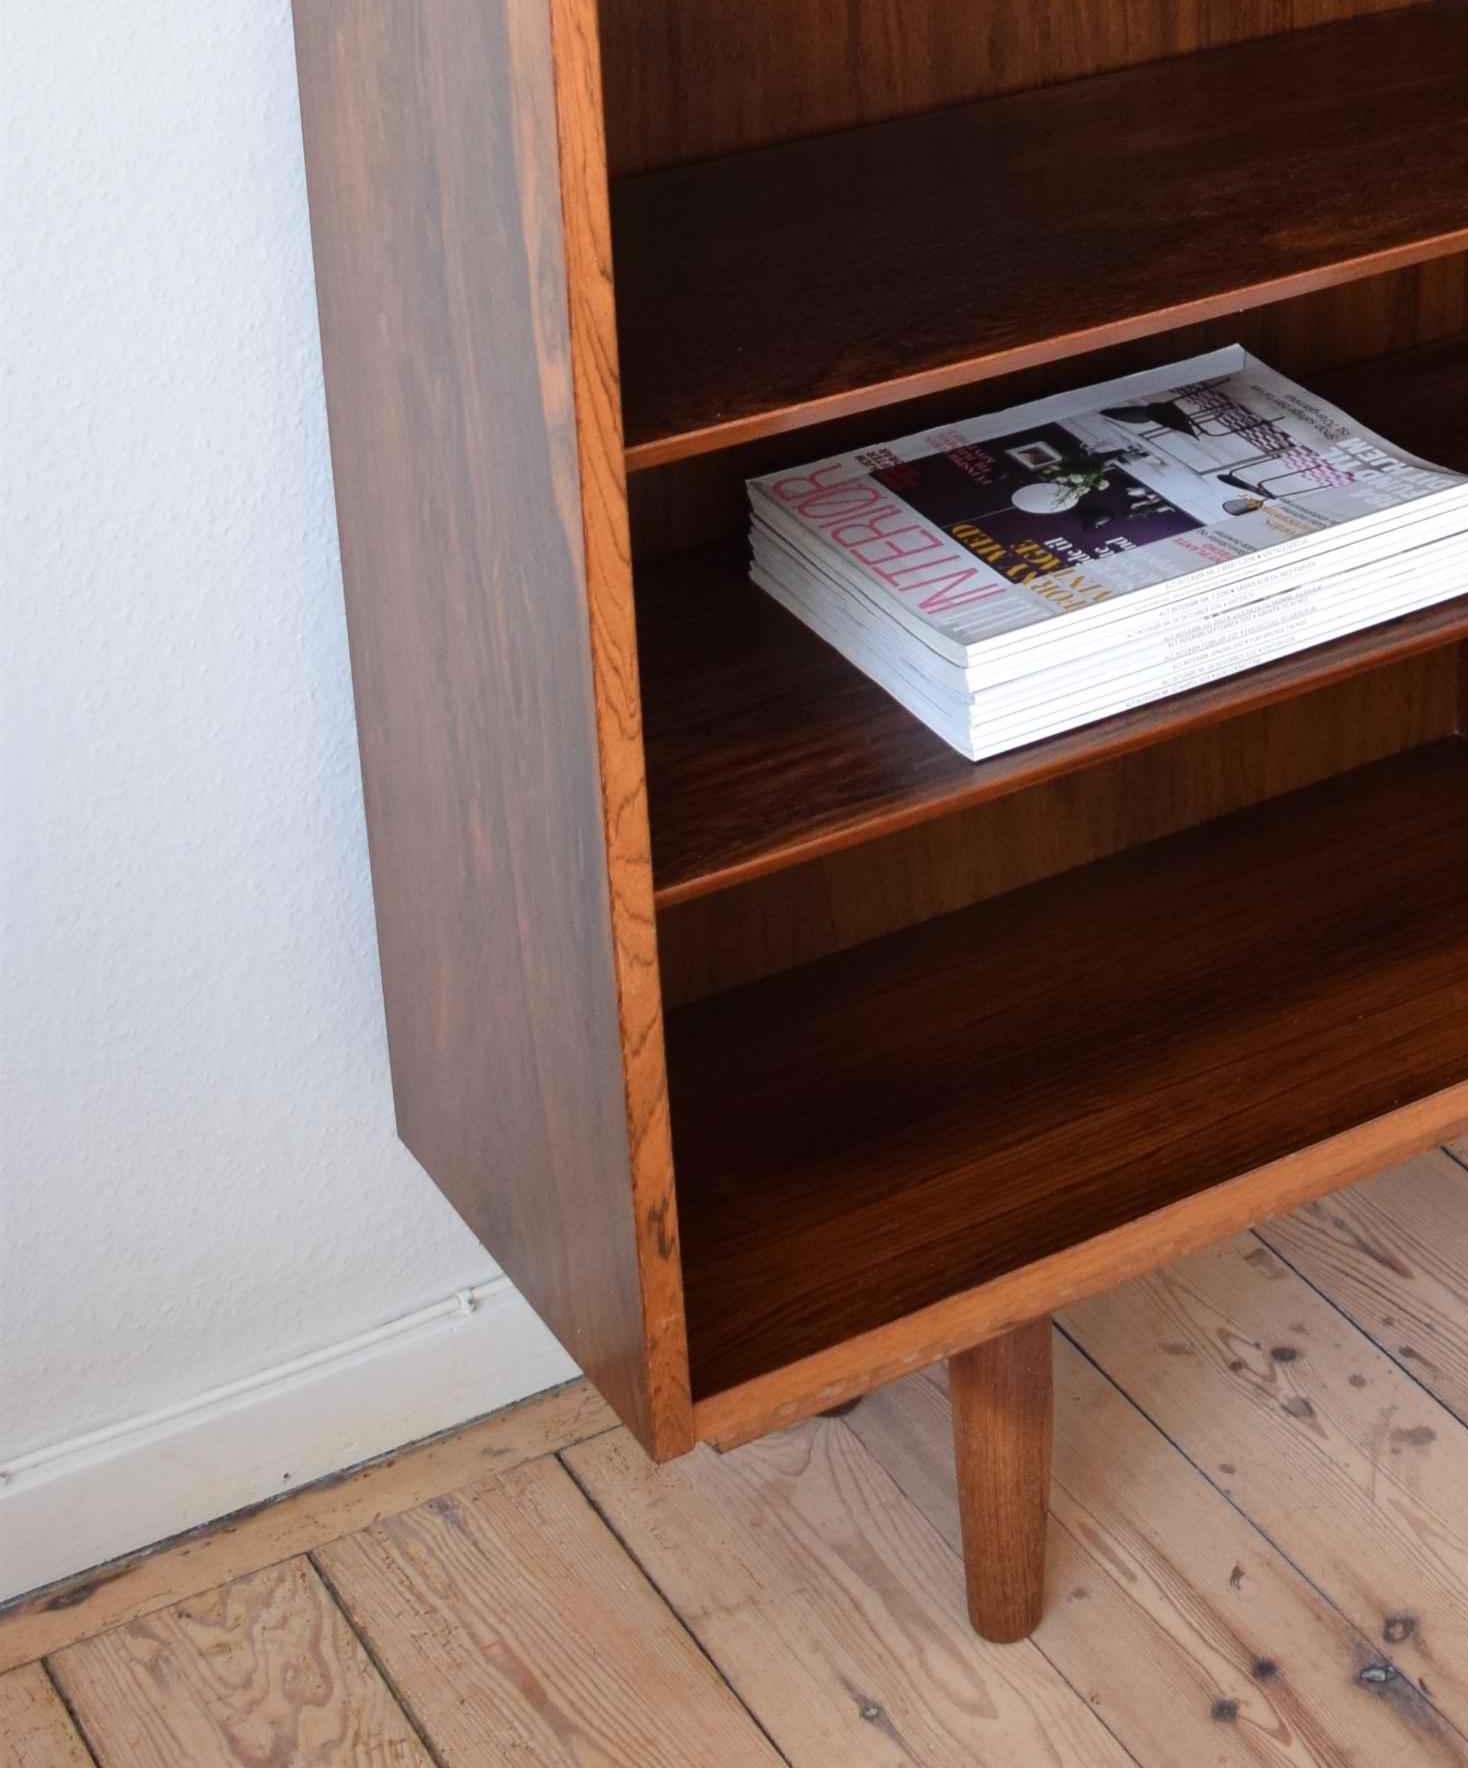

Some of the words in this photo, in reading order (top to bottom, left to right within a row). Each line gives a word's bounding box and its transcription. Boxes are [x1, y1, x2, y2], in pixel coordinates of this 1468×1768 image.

[1336, 436, 1416, 476] HJEM
[772, 463, 1007, 615] INTERIØR
[951, 523, 1008, 564] MED
[1043, 536, 1065, 552] til
[1006, 562, 1087, 612] FORNY
[1011, 539, 1113, 602] VINTAGE
